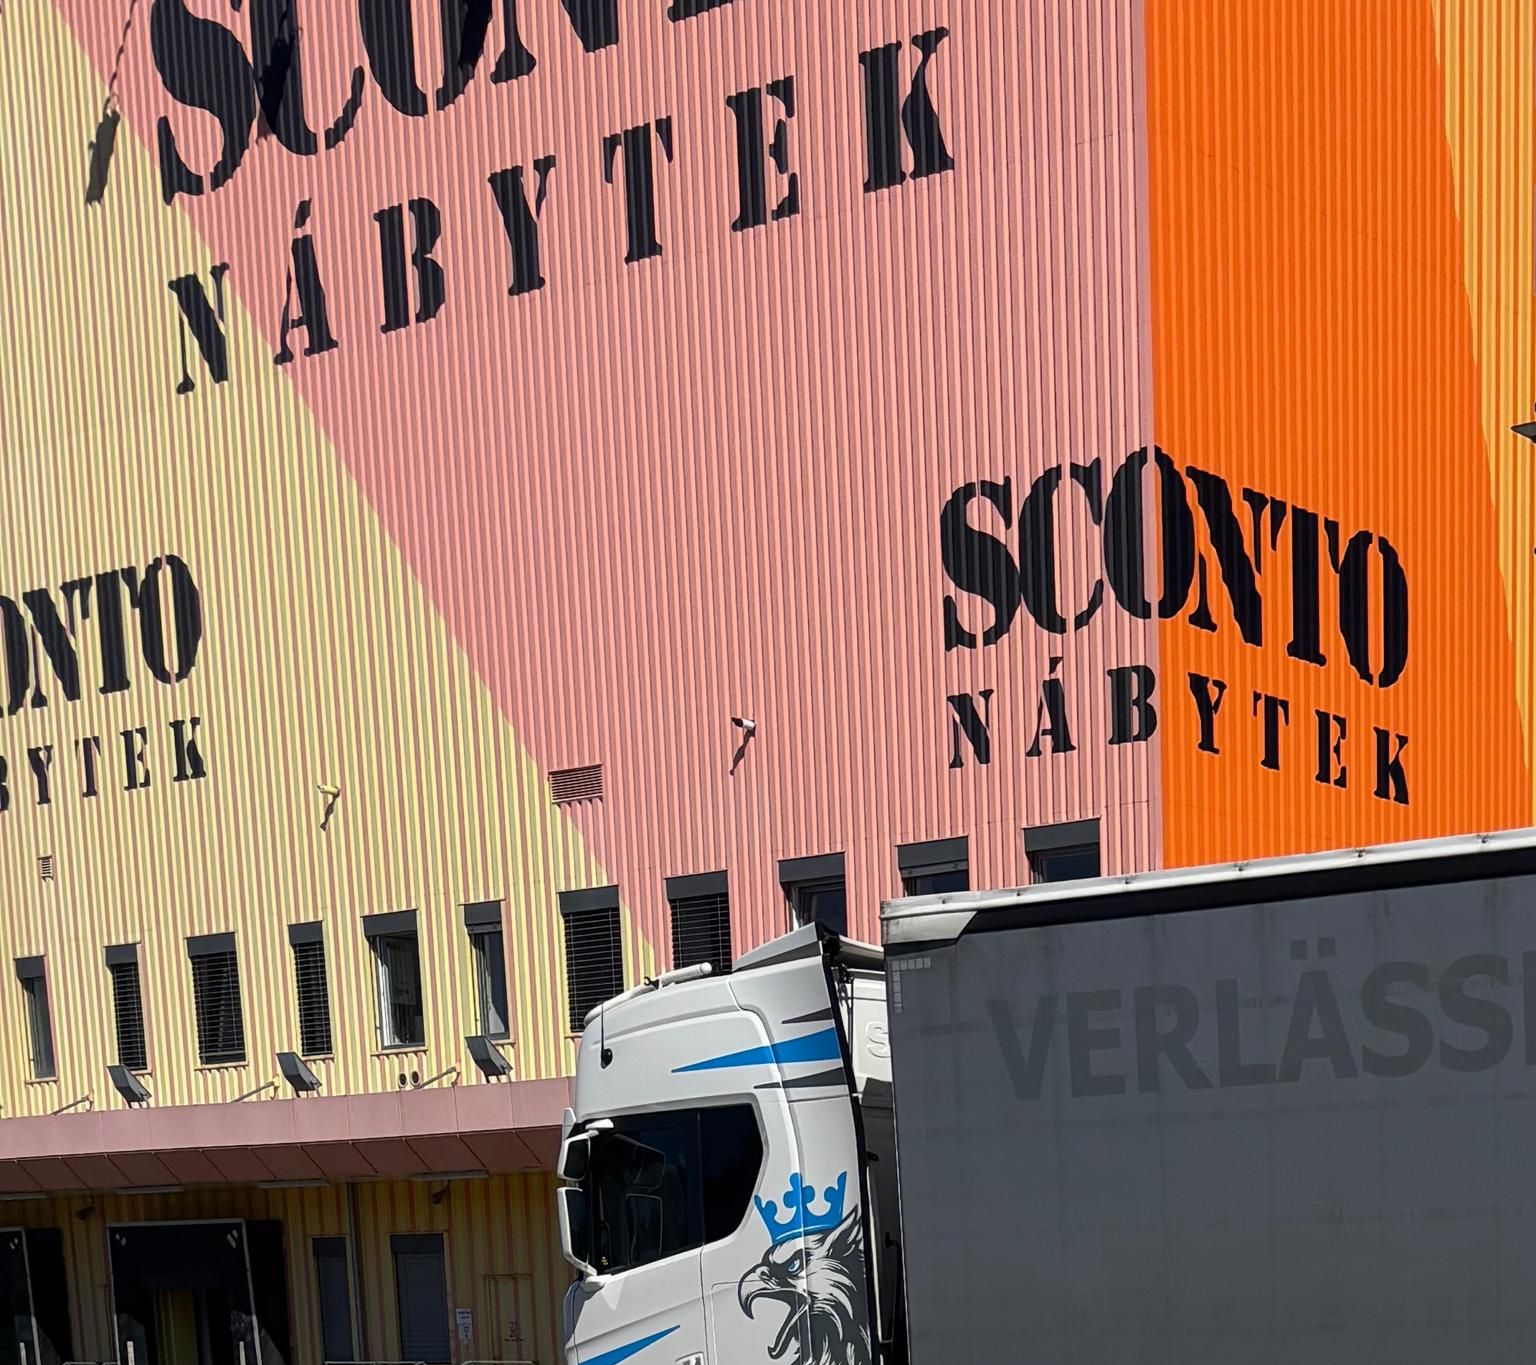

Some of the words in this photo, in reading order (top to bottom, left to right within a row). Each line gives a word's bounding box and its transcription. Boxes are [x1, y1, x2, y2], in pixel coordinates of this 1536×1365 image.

[168, 28, 954, 395] NÁBYTEK
[940, 445, 1409, 688] SCONTO
[947, 656, 1410, 805] NÁBYTEK
